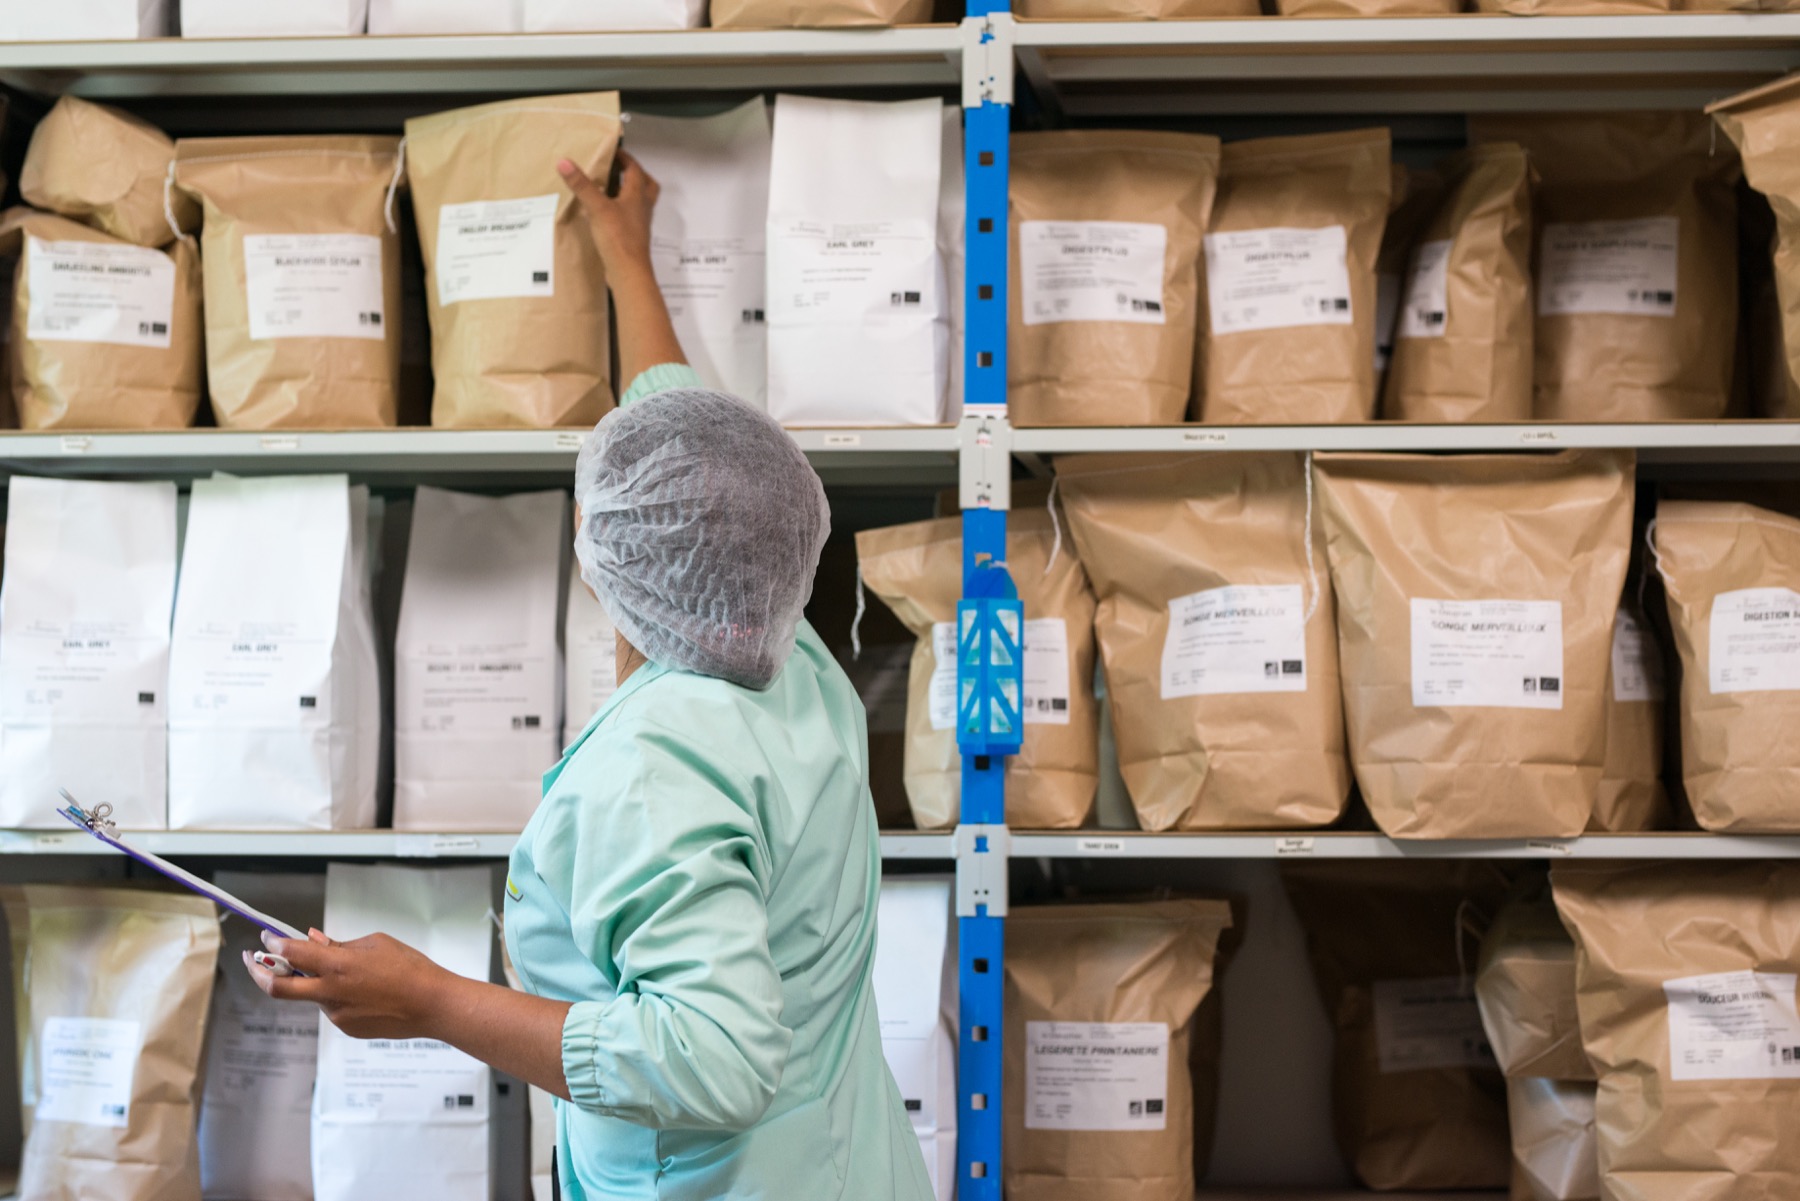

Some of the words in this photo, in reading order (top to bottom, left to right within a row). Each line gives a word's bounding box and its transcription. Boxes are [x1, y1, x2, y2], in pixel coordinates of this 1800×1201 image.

[826, 240, 848, 249] EARL
[851, 240, 874, 249] GREY
[1182, 612, 1212, 627] SONGE
[1214, 607, 1287, 620] MERVEILLEUX
[1743, 610, 1791, 622] DIGESTION
[1431, 620, 1467, 633] SONGE
[1470, 621, 1547, 634] MERVEILLEUX
[62, 639, 83, 649] EARL
[87, 639, 111, 649] GREY
[232, 643, 252, 653] EARL
[255, 643, 278, 653] GREY
[1697, 992, 1739, 1005] DOUCEUR
[1034, 1045, 1088, 1056] LEGERETE
[1090, 1046, 1160, 1056] PRINTANIERE
